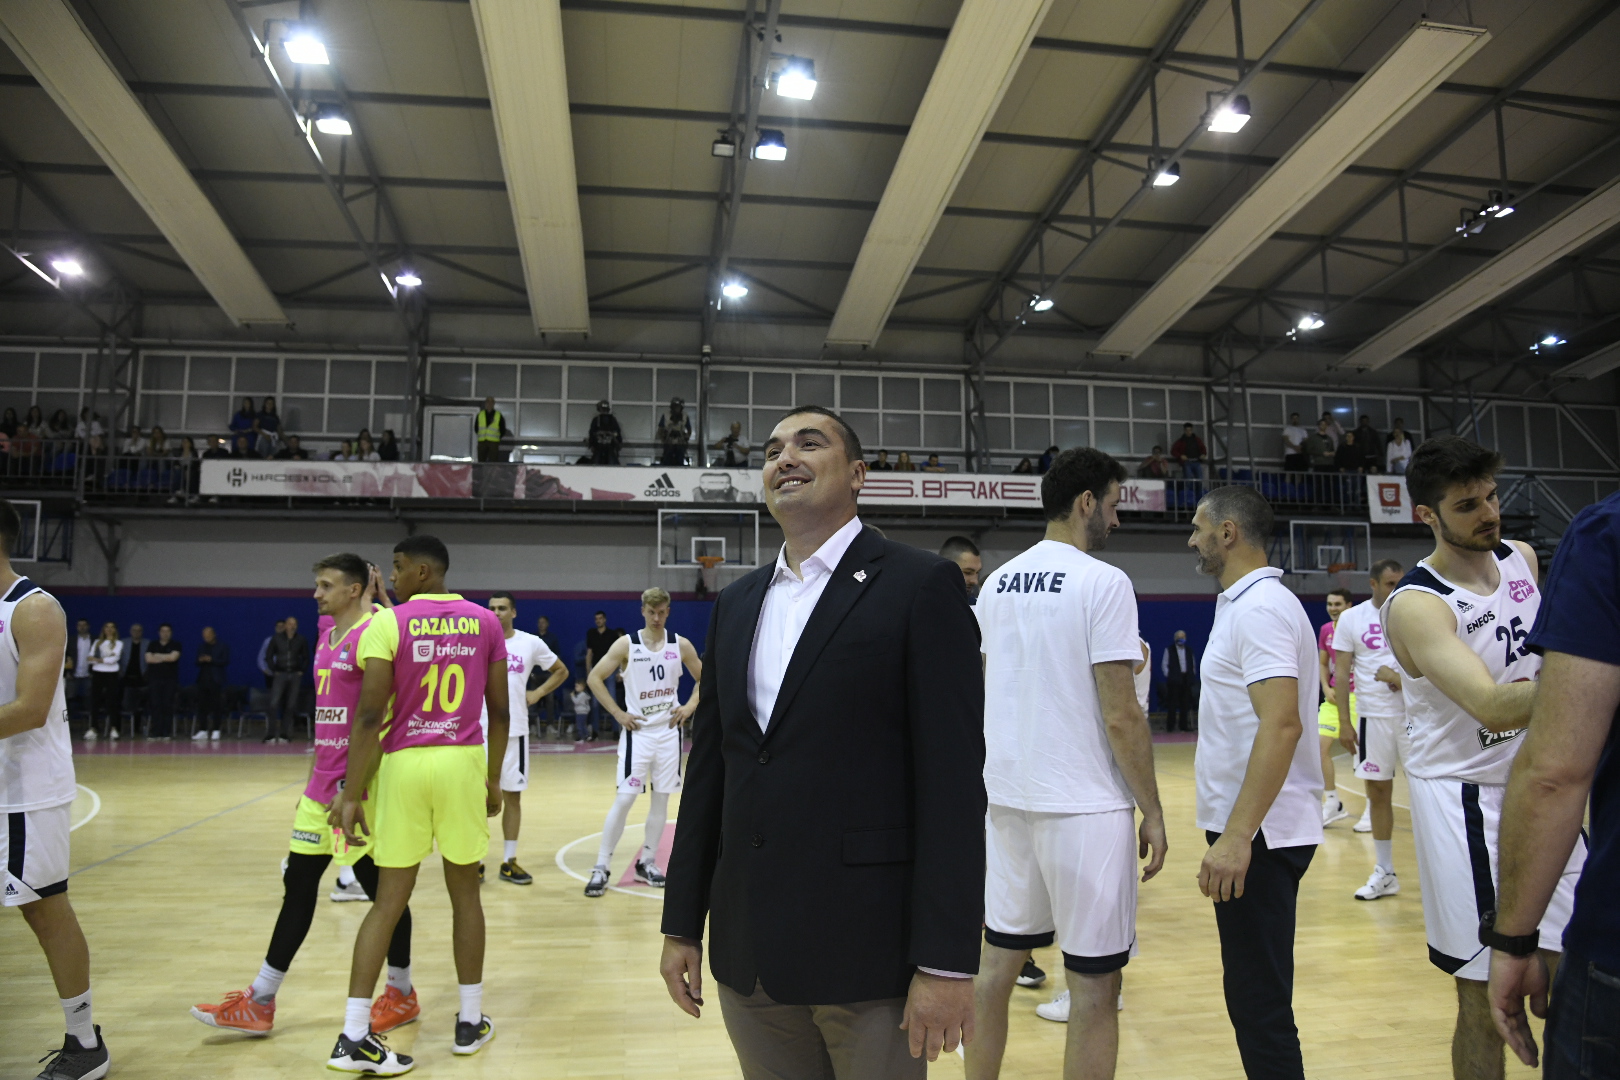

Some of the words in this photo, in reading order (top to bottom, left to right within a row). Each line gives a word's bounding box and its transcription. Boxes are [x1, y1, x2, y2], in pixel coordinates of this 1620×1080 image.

[644, 488, 681, 497] adidas
[996, 571, 1067, 594] SAVKE
[409, 616, 480, 636] CAZALON
[1466, 610, 1496, 635] ENEOS
[436, 642, 477, 659] triglav
[1495, 615, 1530, 667] 25
[649, 664, 665, 682] 10
[420, 663, 466, 714] 10
[408, 720, 460, 730] WILKINSON
